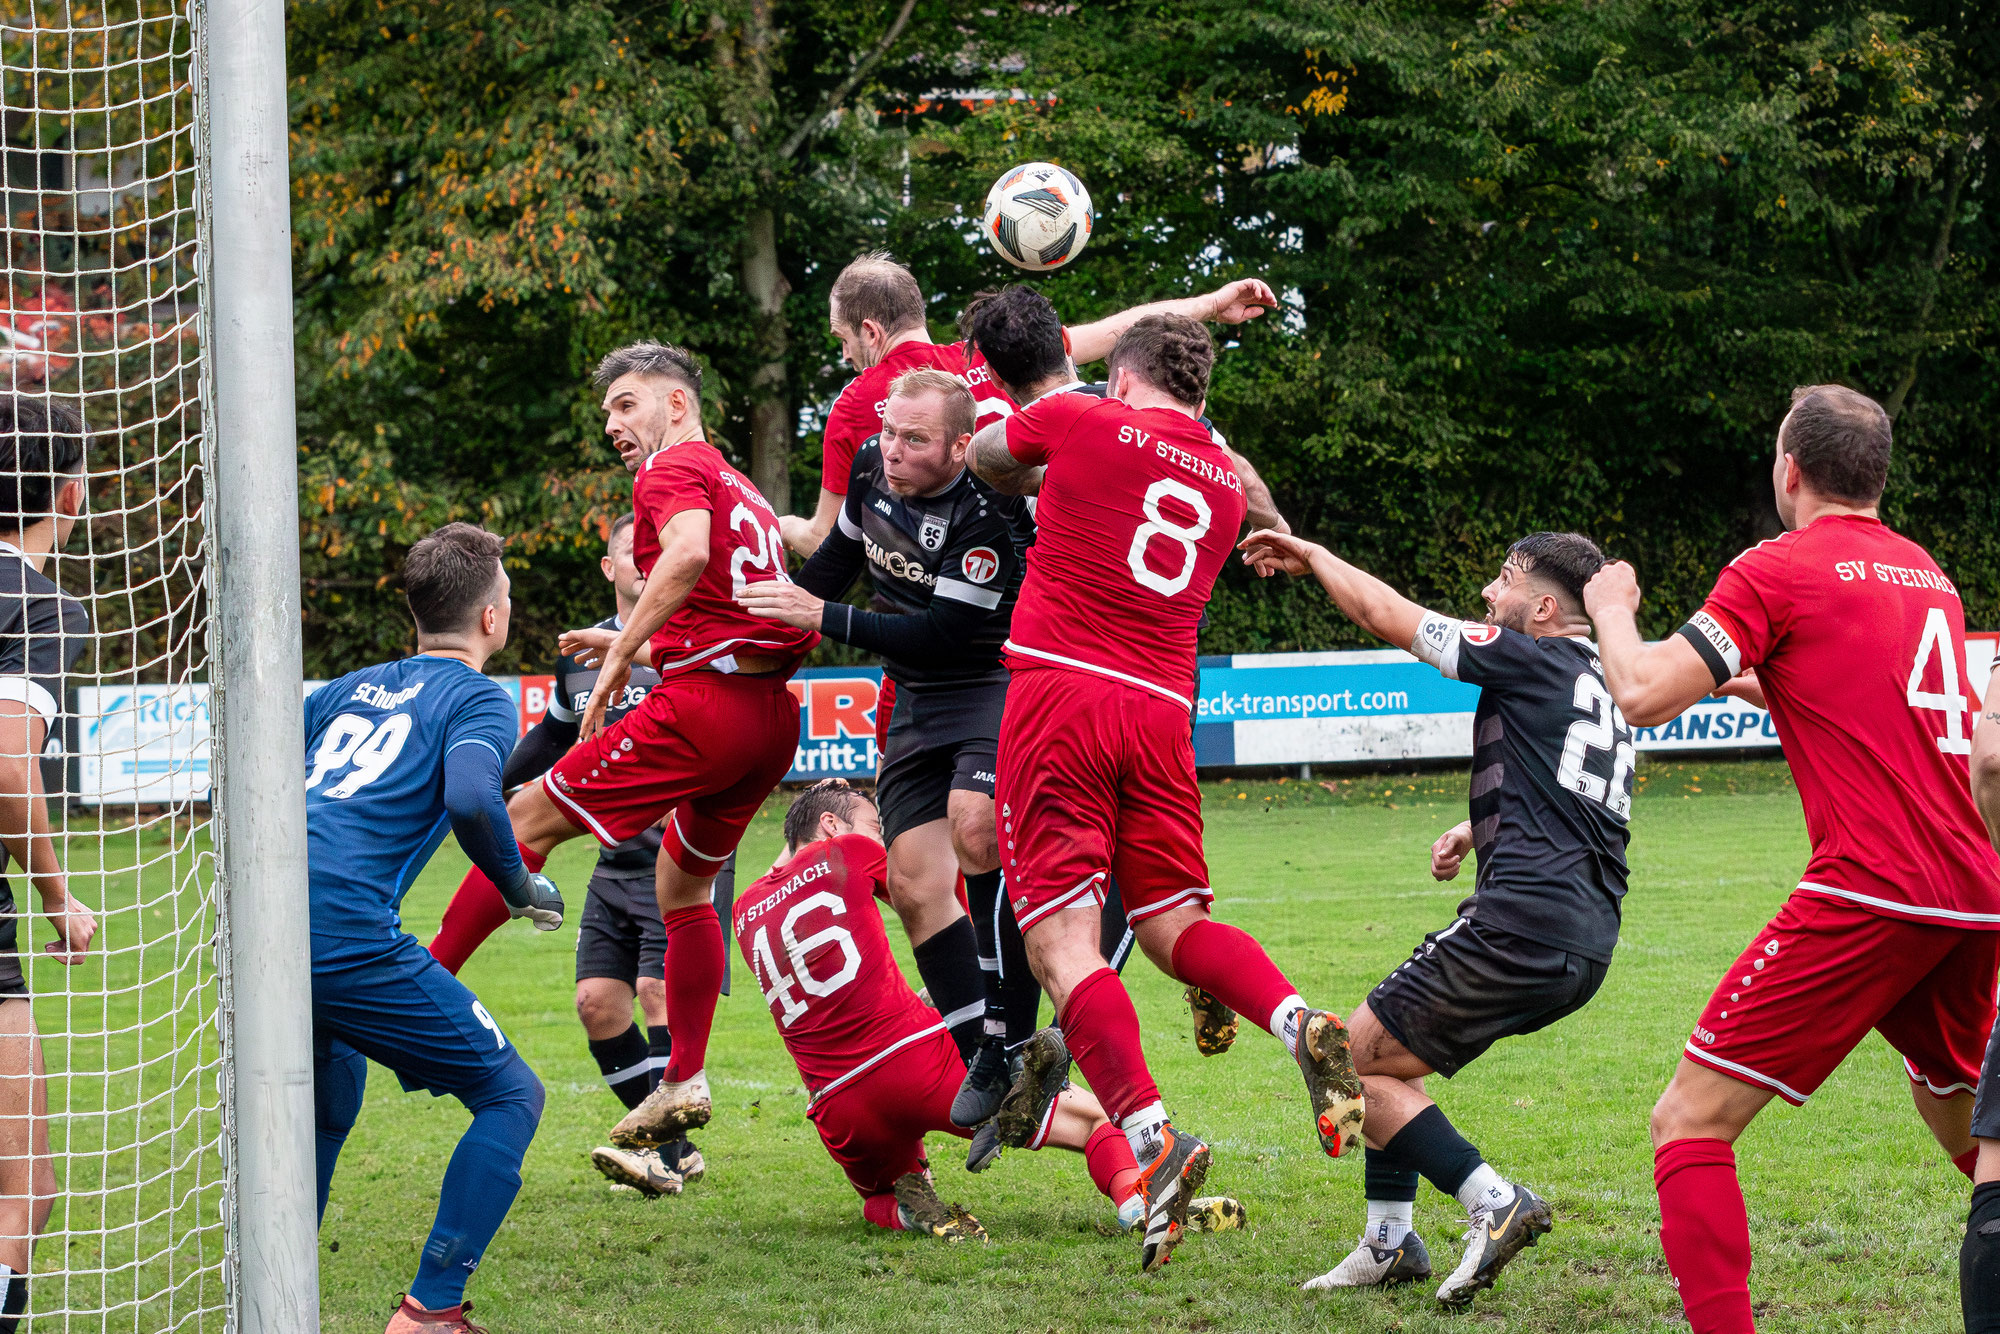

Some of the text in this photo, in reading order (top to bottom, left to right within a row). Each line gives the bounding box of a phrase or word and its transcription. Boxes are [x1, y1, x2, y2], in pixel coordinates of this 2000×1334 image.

[720, 471, 739, 488] SV
[1118, 425, 1243, 495] SV STEINACH
[1127, 477, 1212, 597] 8
[1835, 561, 1866, 581] SV
[1907, 608, 1972, 755] 4
[305, 713, 412, 799] 99
[973, 771, 996, 783] JAK
[748, 860, 832, 922] STEINACH
[752, 891, 862, 1028] 46
